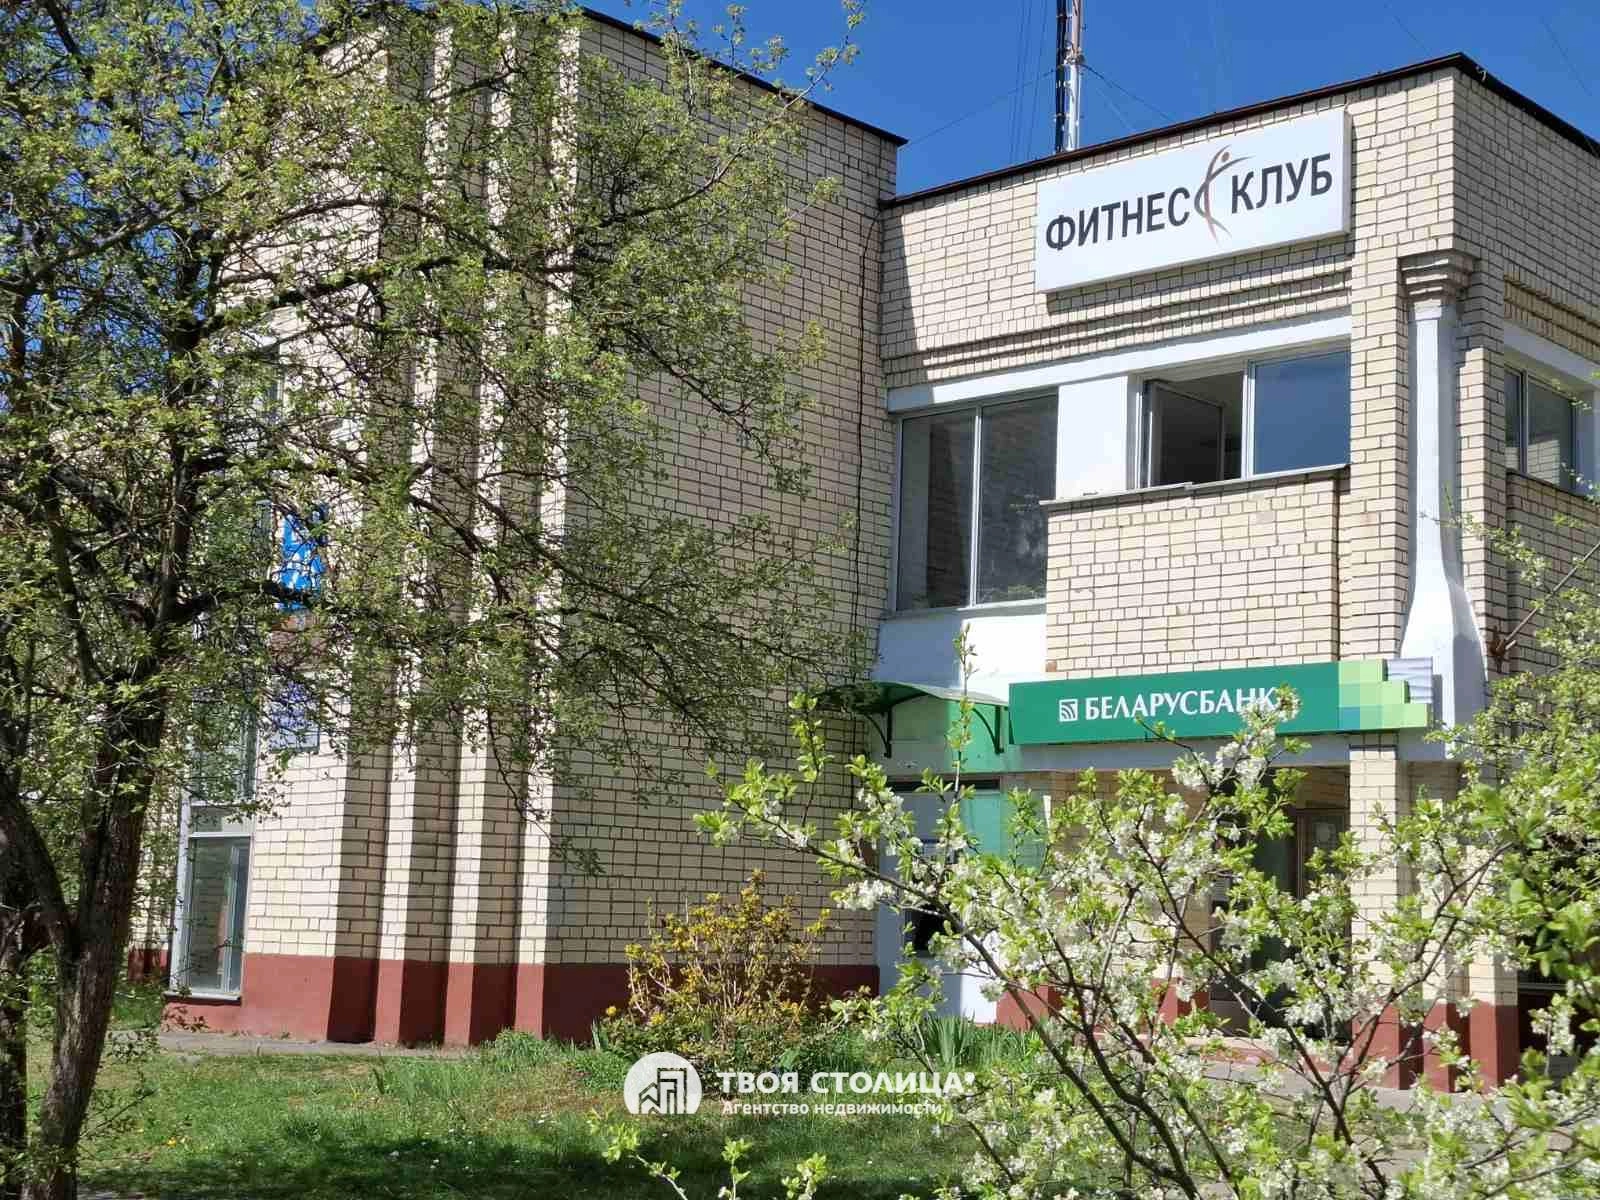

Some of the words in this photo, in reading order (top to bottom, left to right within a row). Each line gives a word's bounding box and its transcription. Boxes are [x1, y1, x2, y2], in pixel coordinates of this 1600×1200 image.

[1045, 186, 1191, 251] ФИТНЕС
[1231, 153, 1333, 214] КЛУБ
[1084, 687, 1278, 721] БЕЛАРУСБАНК
